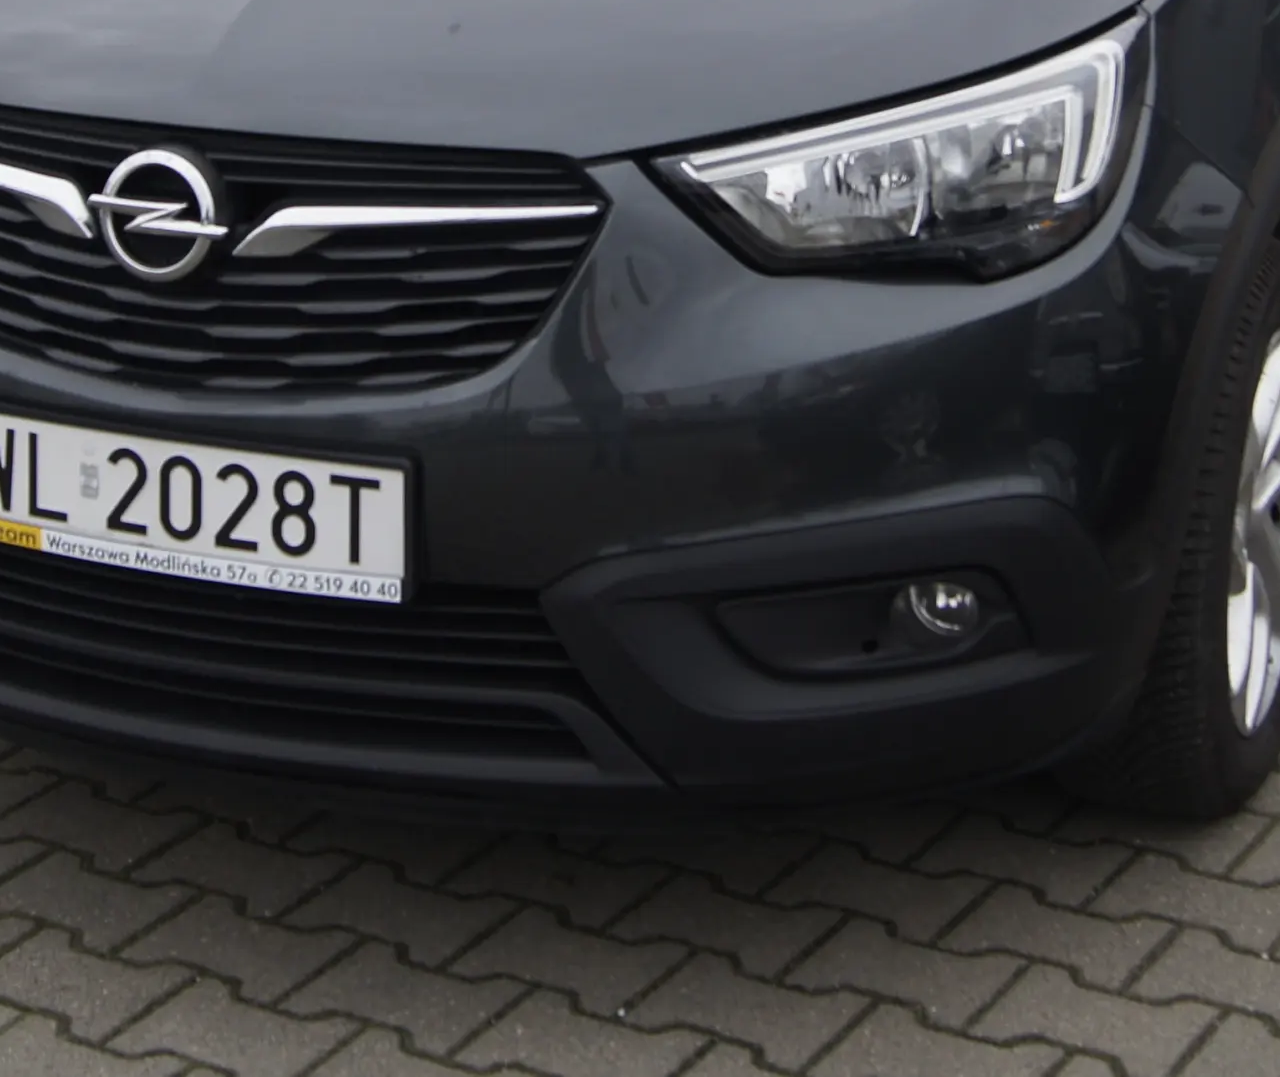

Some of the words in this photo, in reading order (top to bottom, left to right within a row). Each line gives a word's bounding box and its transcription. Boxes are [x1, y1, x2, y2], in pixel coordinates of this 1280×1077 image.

[106, 447, 381, 564] 2028T
[46, 534, 130, 564] Warszawa
[134, 550, 221, 579] Modlińska
[226, 564, 258, 584] 57a
[287, 574, 308, 591] 22
[314, 577, 343, 594] 519
[349, 580, 371, 597] 40
[376, 582, 399, 600] 40
